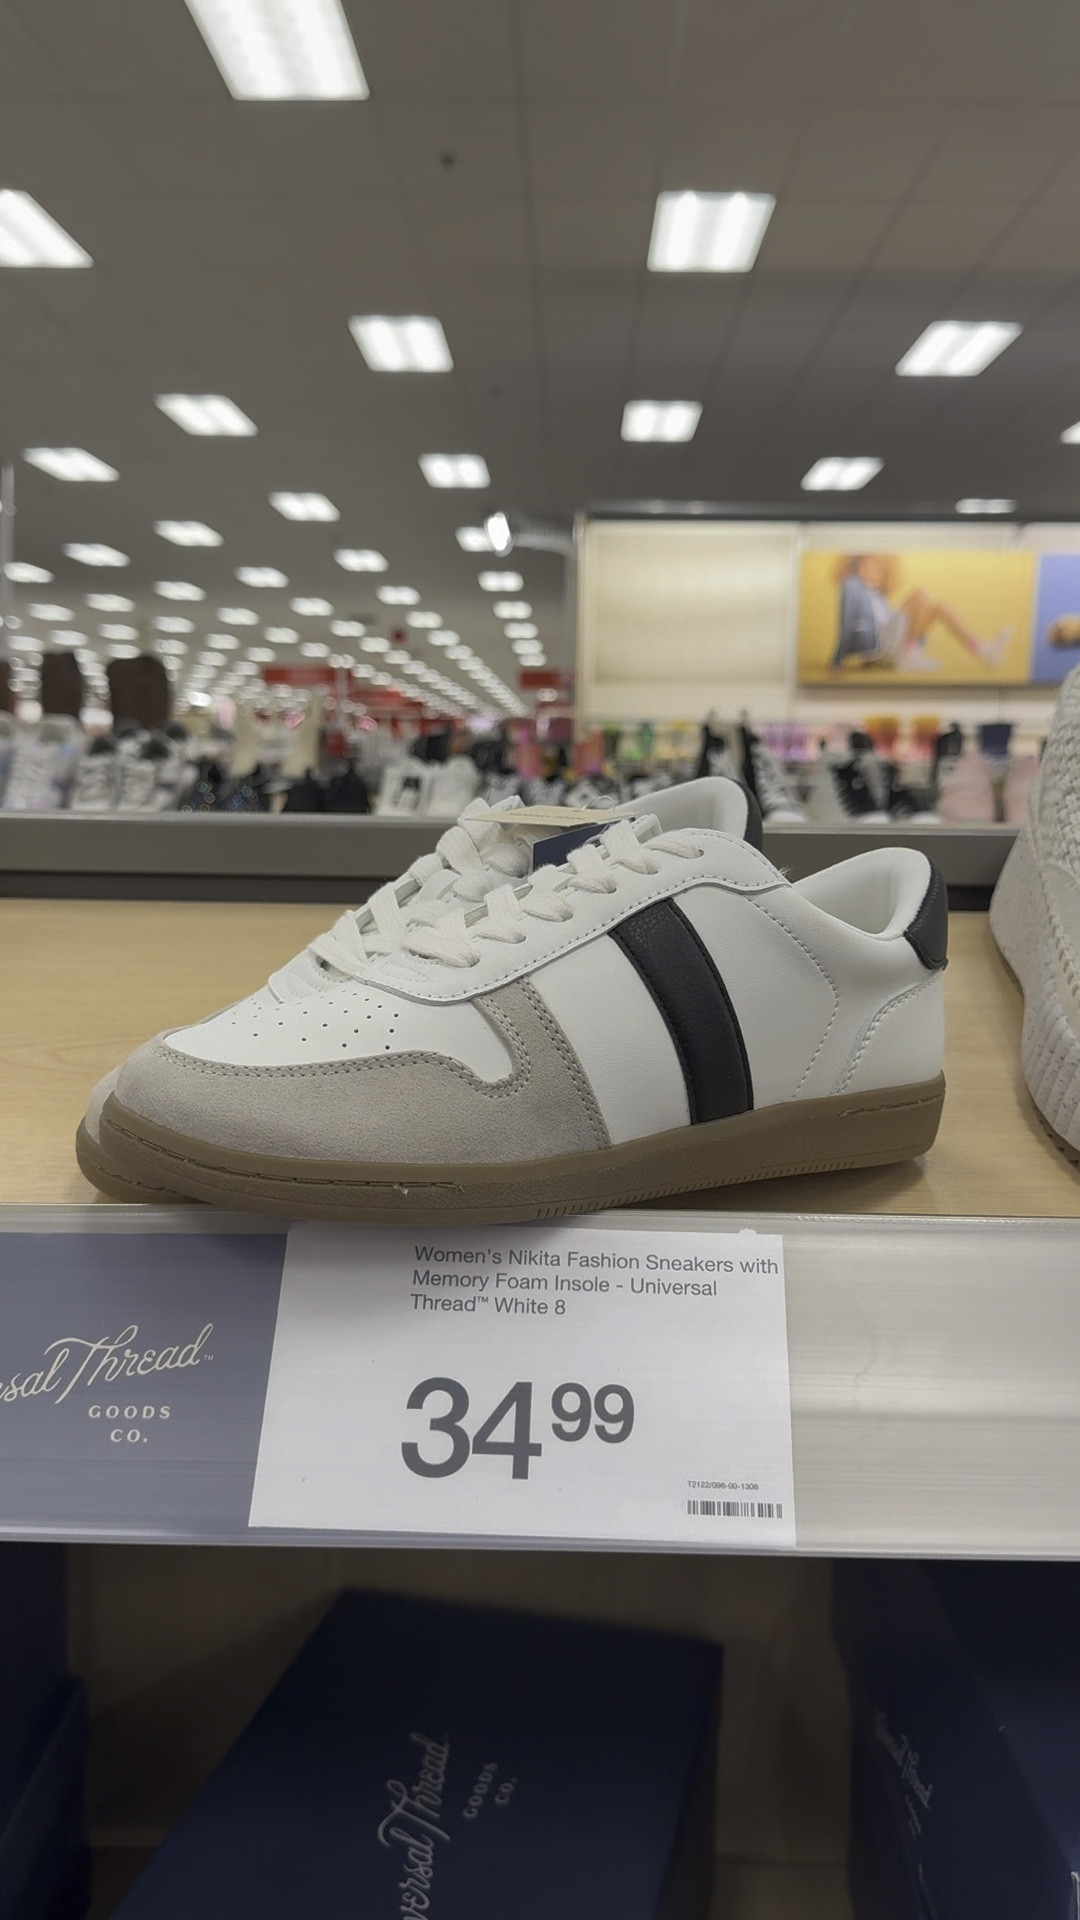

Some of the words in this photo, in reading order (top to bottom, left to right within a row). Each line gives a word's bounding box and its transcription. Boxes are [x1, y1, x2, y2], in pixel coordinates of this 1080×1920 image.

[415, 1246, 502, 1265] Women's
[508, 1249, 561, 1267] Nikita
[567, 1251, 640, 1270] Fashion
[645, 1254, 734, 1273] Sneakers
[739, 1257, 779, 1275] with
[412, 1269, 490, 1292] Memory
[495, 1273, 548, 1291] Foam
[554, 1275, 610, 1293] Insole
[630, 1278, 717, 1297] Universal
[494, 1296, 549, 1315] White
[554, 1299, 566, 1316] 8
[88, 1404, 171, 1420] GOODS
[110, 1428, 148, 1443] CO.
